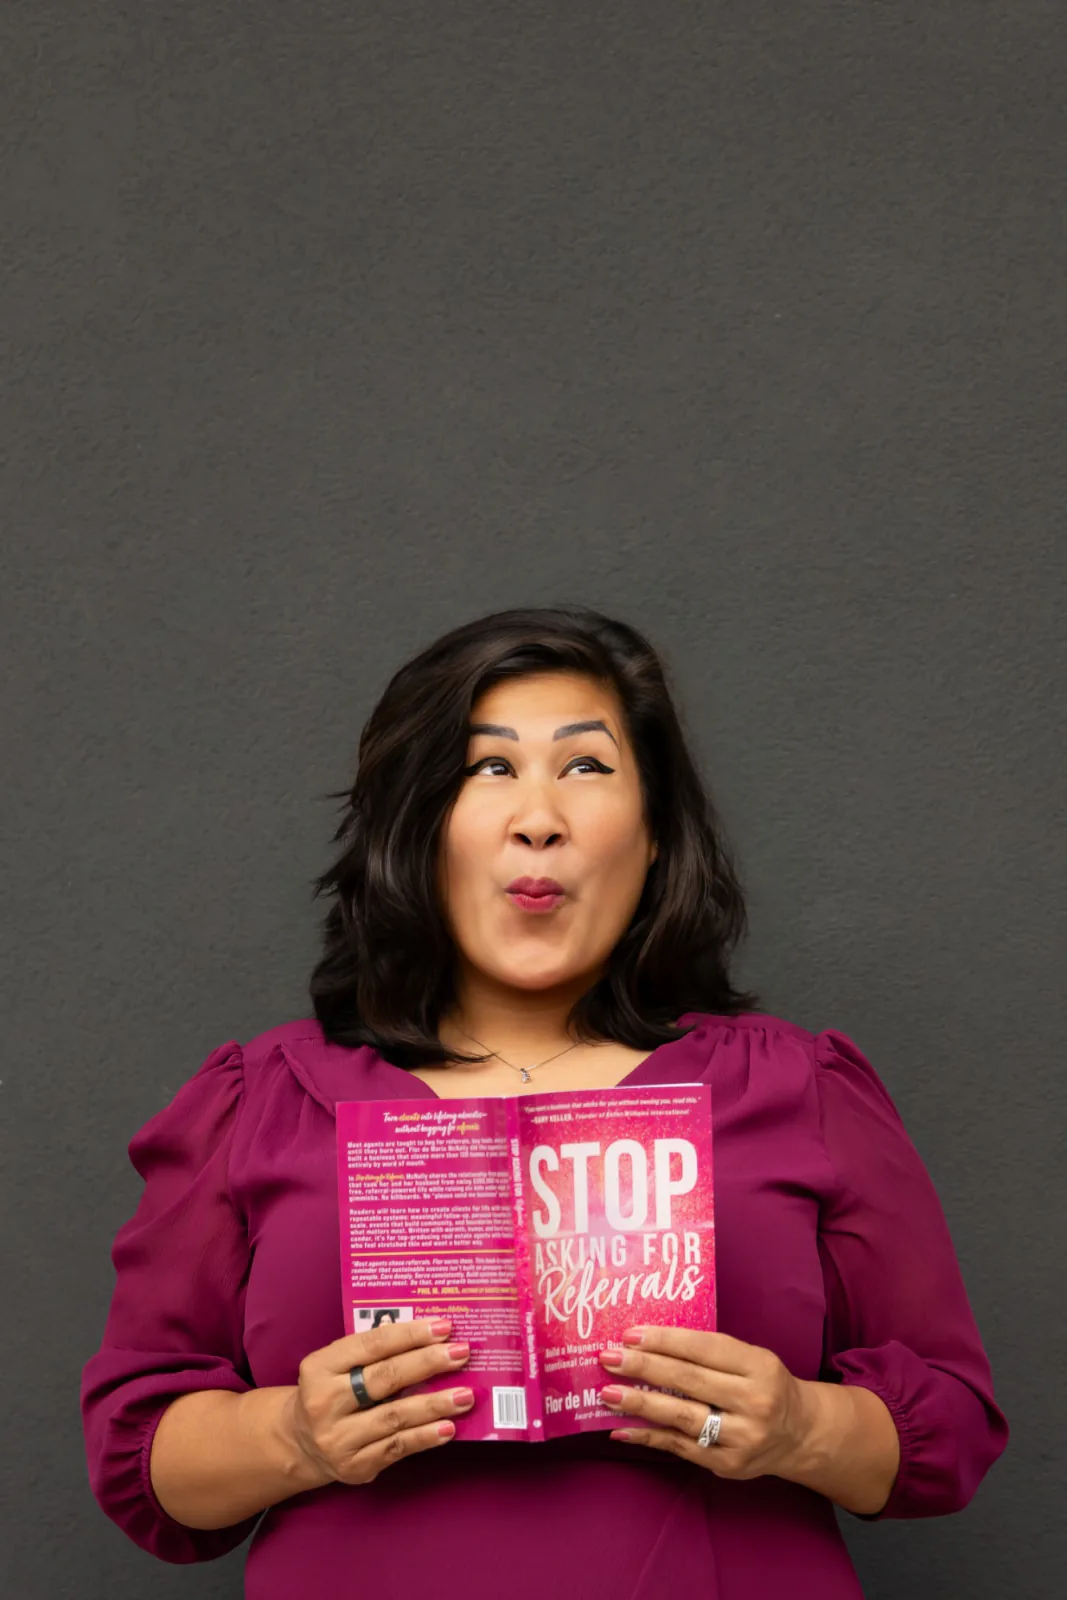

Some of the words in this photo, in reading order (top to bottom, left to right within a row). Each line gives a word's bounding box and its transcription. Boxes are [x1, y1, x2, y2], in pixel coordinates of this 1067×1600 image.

[383, 1112, 398, 1122] Turn
[549, 1113, 574, 1122] KELLER,
[510, 1138, 519, 1156] STOP
[529, 1138, 698, 1238] STOP
[535, 1234, 626, 1276] ASKING
[643, 1230, 700, 1266] FOR
[538, 1256, 704, 1339] Referrals
[545, 1347, 560, 1358] Build
[566, 1342, 604, 1354] Magnetic
[607, 1340, 624, 1350] Bus
[579, 1356, 598, 1366] Care
[545, 1395, 562, 1415] Flor
[565, 1392, 580, 1409] de
[583, 1388, 602, 1406] Ma
